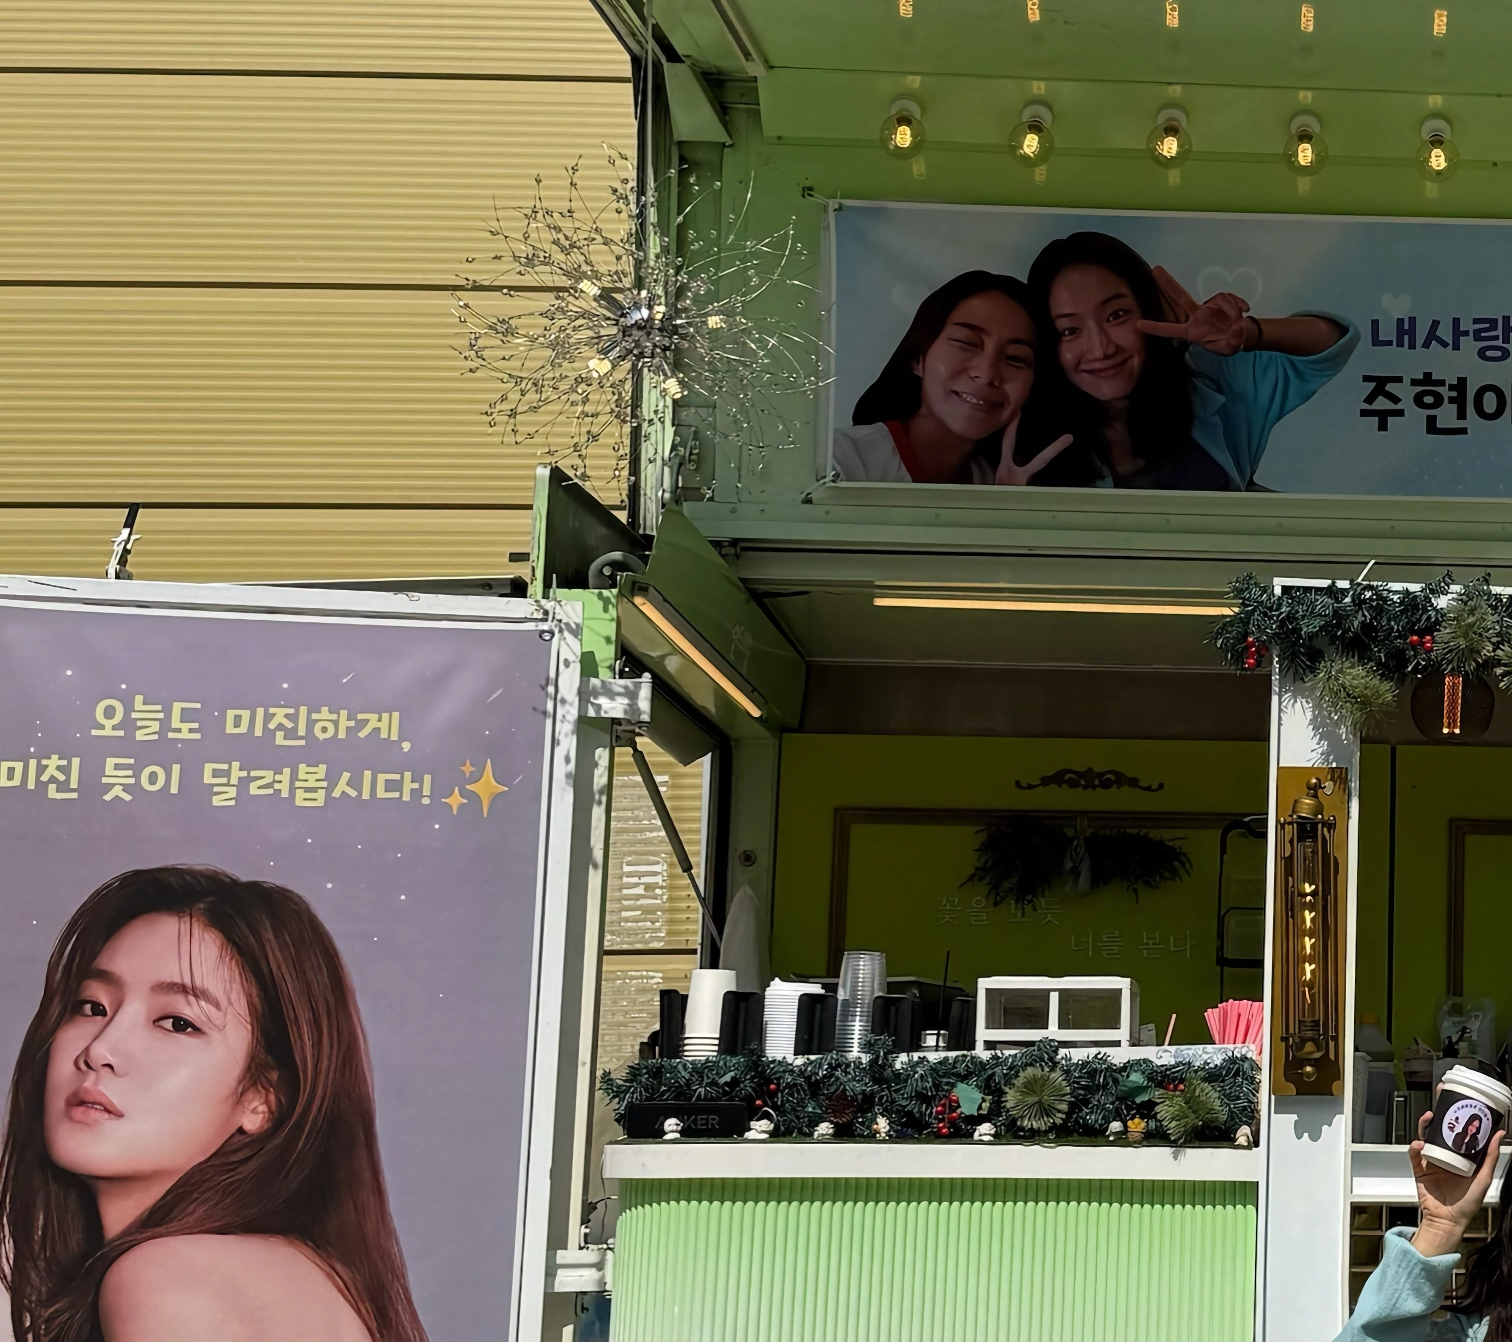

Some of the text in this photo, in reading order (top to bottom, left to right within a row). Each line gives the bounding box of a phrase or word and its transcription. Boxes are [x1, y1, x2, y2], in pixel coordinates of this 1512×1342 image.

[91, 694, 412, 752] 오늘도 미진하게,
[0, 754, 432, 807] 미친 듯이 달려봅시다!
[936, 896, 993, 926] 꽃을
[1070, 928, 1198, 960] 너를 본다
